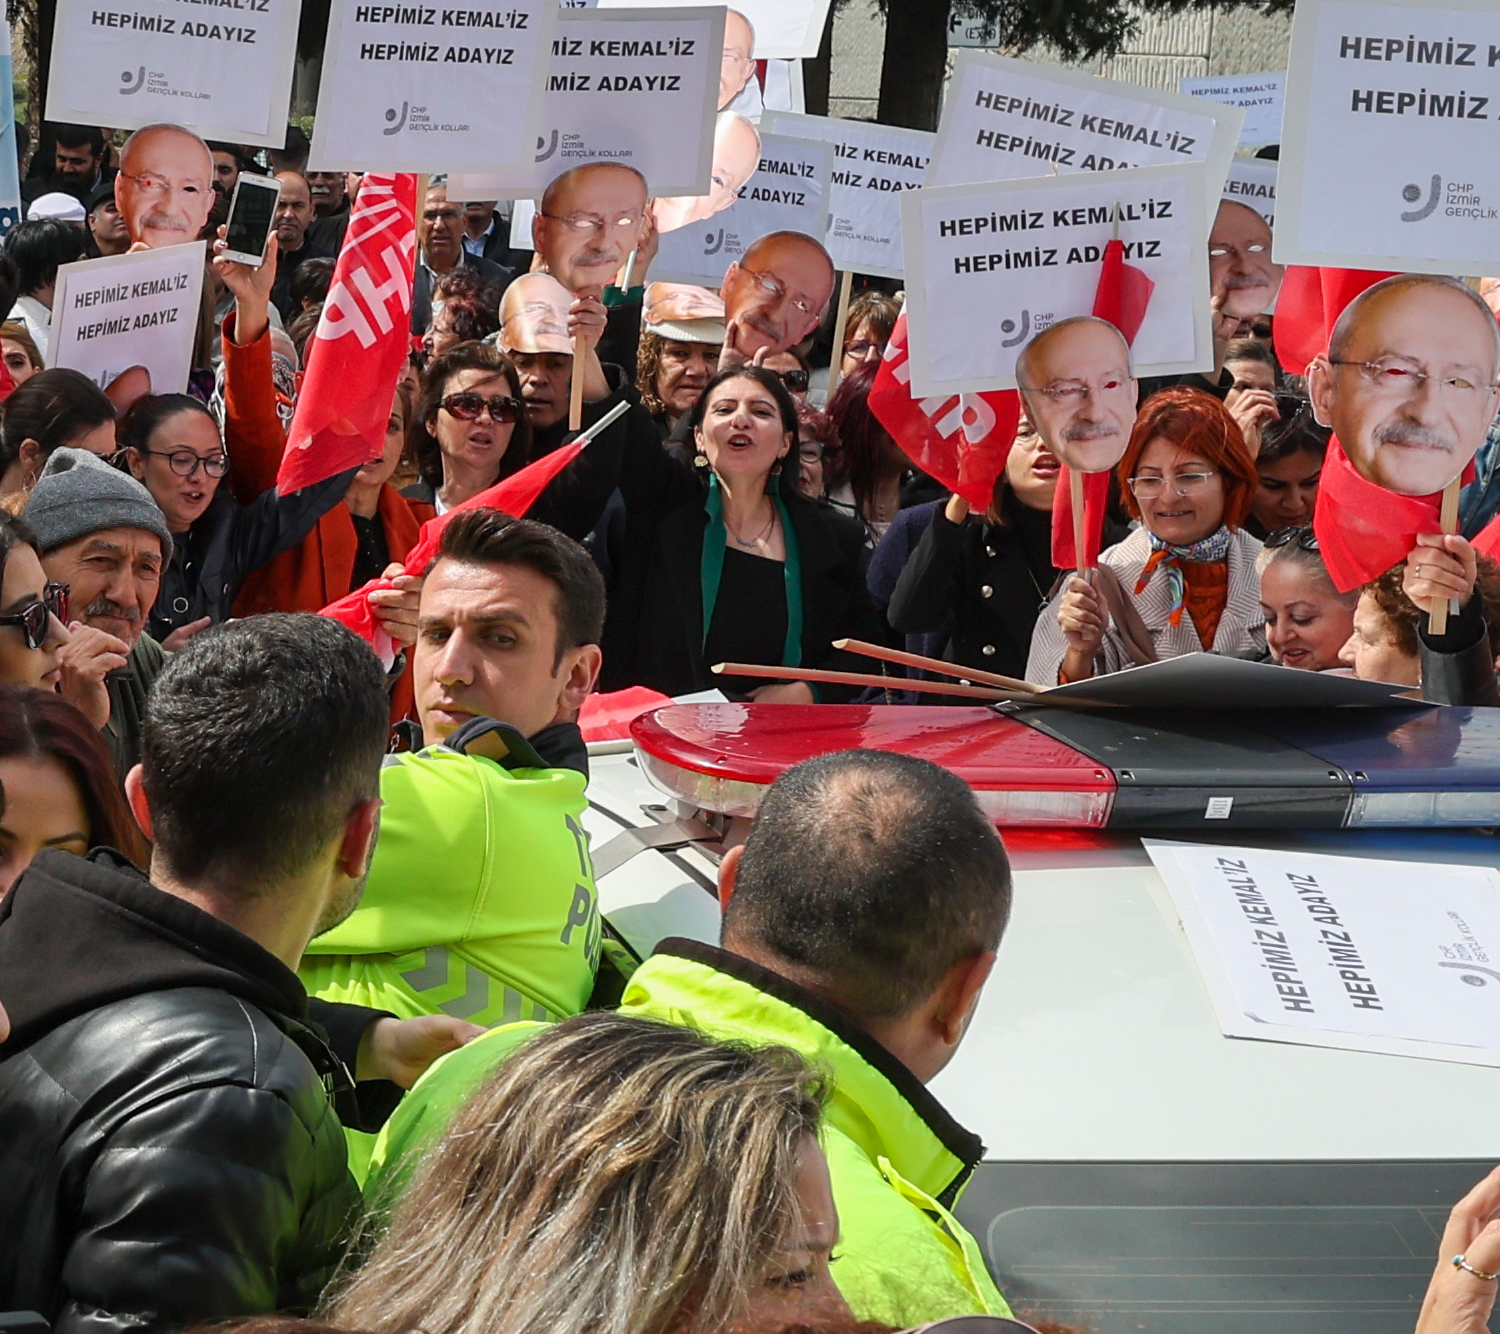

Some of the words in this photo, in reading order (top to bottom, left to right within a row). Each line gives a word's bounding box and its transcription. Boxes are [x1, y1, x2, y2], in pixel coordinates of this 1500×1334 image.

[92, 11, 175, 34] HEPİMİZ
[181, 22, 256, 43] ADAYIZ
[355, 3, 436, 25] HEPİMİZ
[441, 9, 529, 29] KEMAL'İZ
[360, 41, 440, 62] HEPİMİZ
[444, 46, 514, 64] ADAYIZ
[589, 37, 695, 57] KEMAL'İZ
[1340, 35, 1476, 67] HEPİMİZ
[180, 91, 211, 100] KOLLARI
[597, 75, 681, 91] ADAYIZ
[1191, 88, 1230, 96] HEPİMİZ
[1233, 84, 1278, 94] KEMAL'İZ
[1238, 98, 1274, 107] ADAYIZ
[1351, 88, 1489, 120] HEPİMİZ
[975, 90, 1075, 127] HEPİMİZ
[1080, 115, 1196, 155] KEMAL'İZ
[598, 149, 632, 157] KOLLARI
[976, 129, 1076, 166] HEPİMİZ
[1080, 154, 1140, 171] ADA
[758, 159, 814, 179] EMAL'İZ
[751, 189, 805, 206] ADAYIZ
[1447, 182, 1474, 192] CHP
[940, 210, 1044, 237] HEPİMİZ
[1445, 206, 1497, 220] GENÇLİK
[954, 246, 1058, 274] HEPİMİZ
[1066, 240, 1161, 264] ADYIZ
[75, 283, 128, 308] HEPİMİZ
[132, 273, 188, 298] KEMAL'İZ
[77, 316, 130, 341] HEPİMİZ
[133, 308, 178, 330] ADAYIZ
[1034, 313, 1054, 321] CHP
[1216, 857, 1279, 926] KEMAL'İZ
[1286, 873, 1344, 926] ADAYIZ
[1251, 929, 1315, 1013] HEPİMİZ
[1318, 929, 1383, 1010] HEPİMİZ
